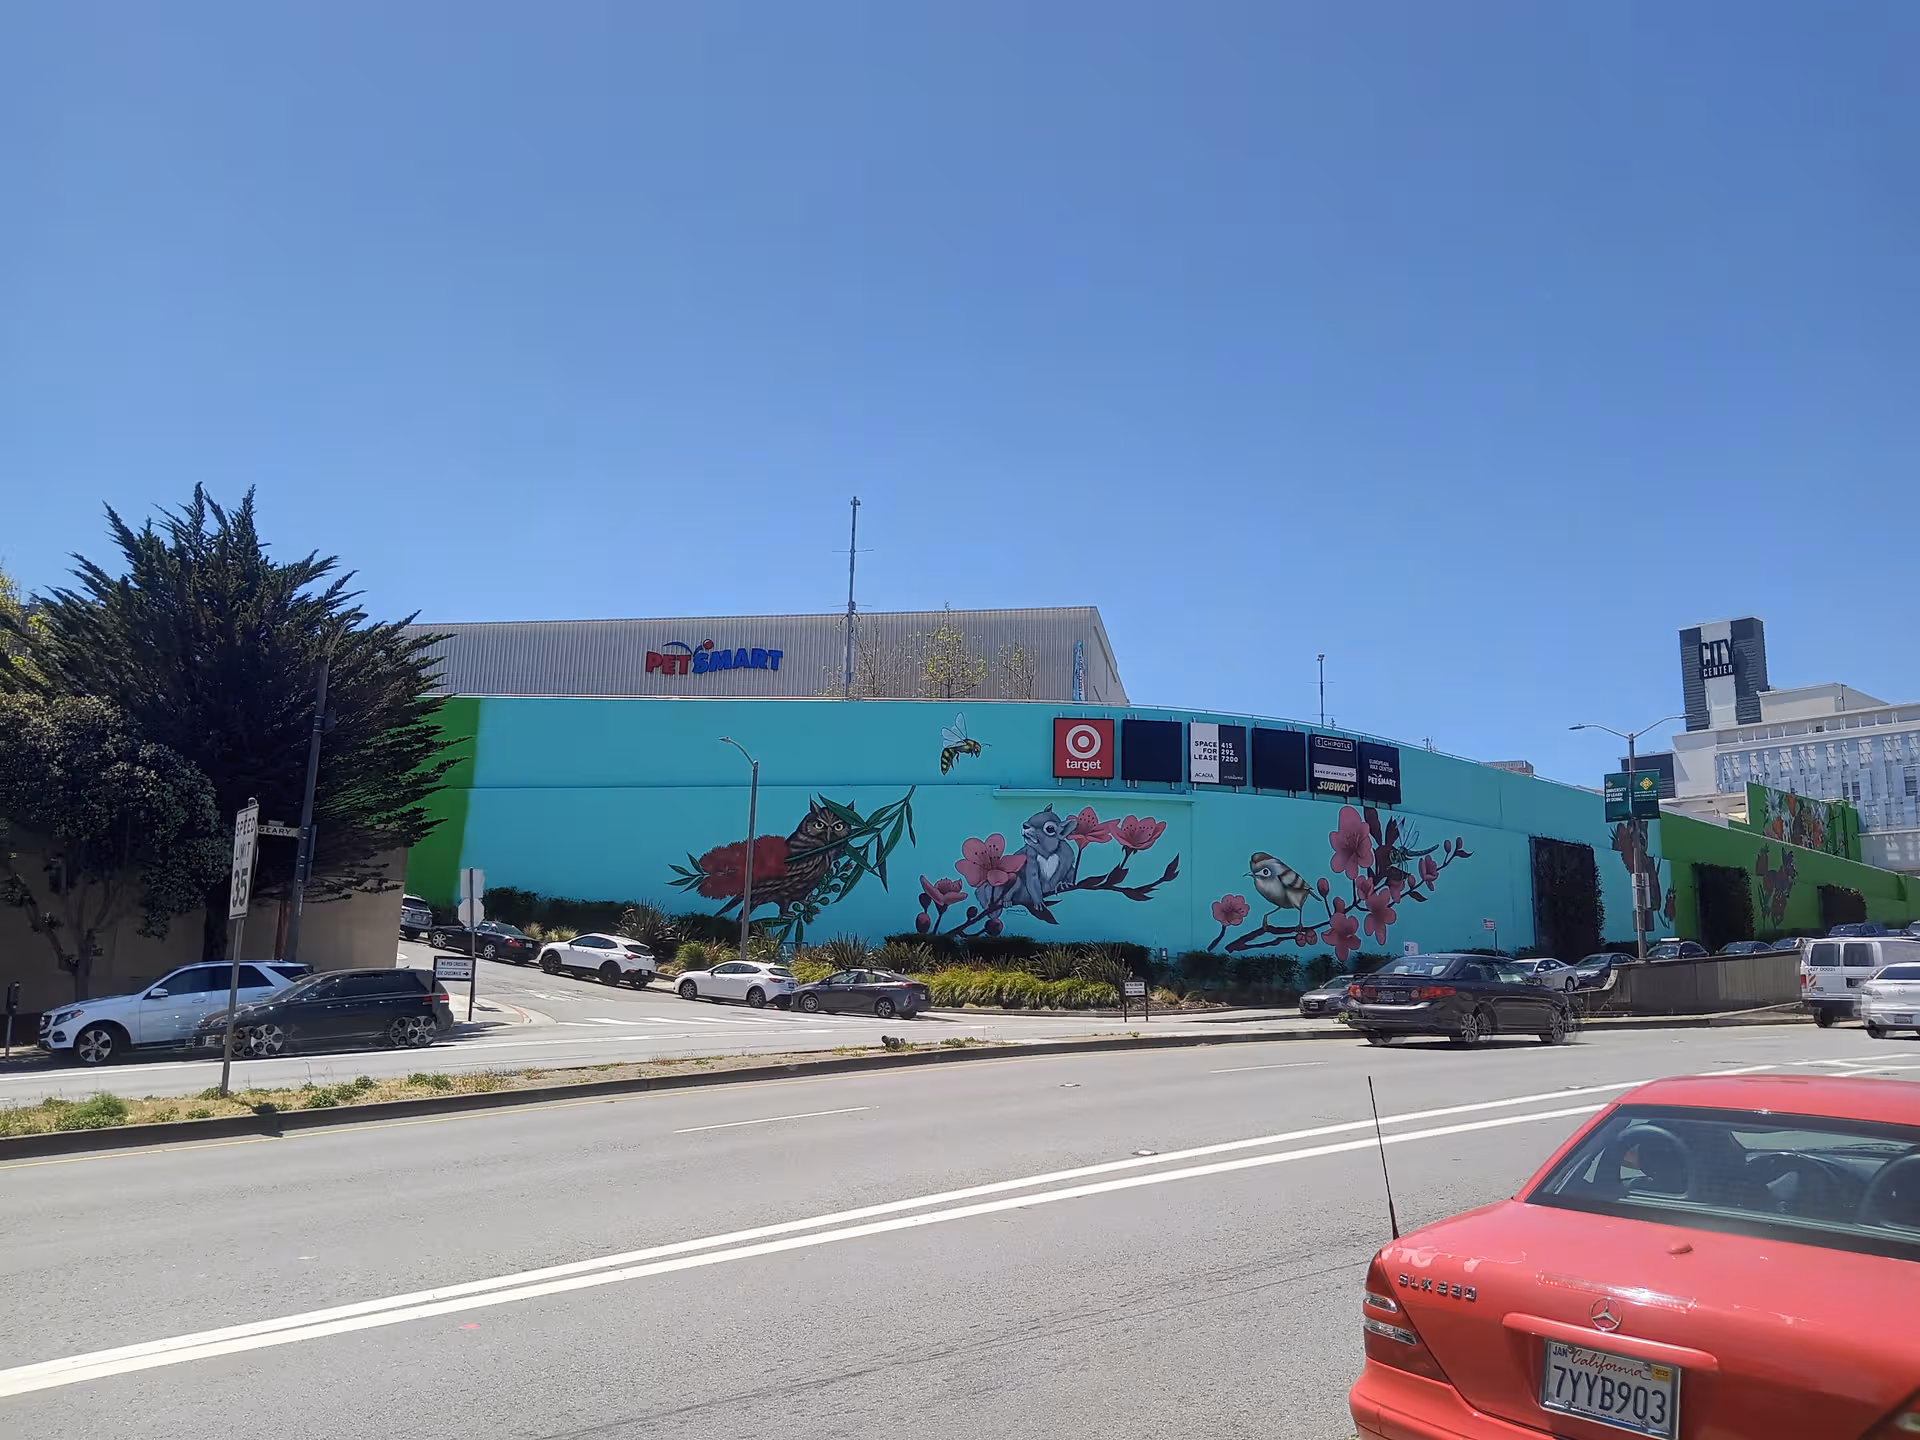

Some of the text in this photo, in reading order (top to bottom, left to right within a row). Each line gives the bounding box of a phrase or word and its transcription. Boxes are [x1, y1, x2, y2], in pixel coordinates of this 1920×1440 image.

[646, 648, 784, 675] PETSMART
[1700, 639, 1734, 667] CITY
[1703, 664, 1733, 677] CENTER
[1323, 740, 1350, 749] CHIPOTLE
[1066, 758, 1102, 771] target
[1317, 781, 1354, 792] SUBWAY
[236, 816, 256, 838] SPEED
[259, 826, 292, 835] GEARY
[236, 842, 251, 860] LIMIT
[232, 868, 248, 908] 35
[1399, 1273, 1476, 1300] SLK 230
[1552, 1346, 1568, 1357] JAN
[1571, 1349, 1651, 1380] California
[1554, 1365, 1666, 1424] 7YYB903
